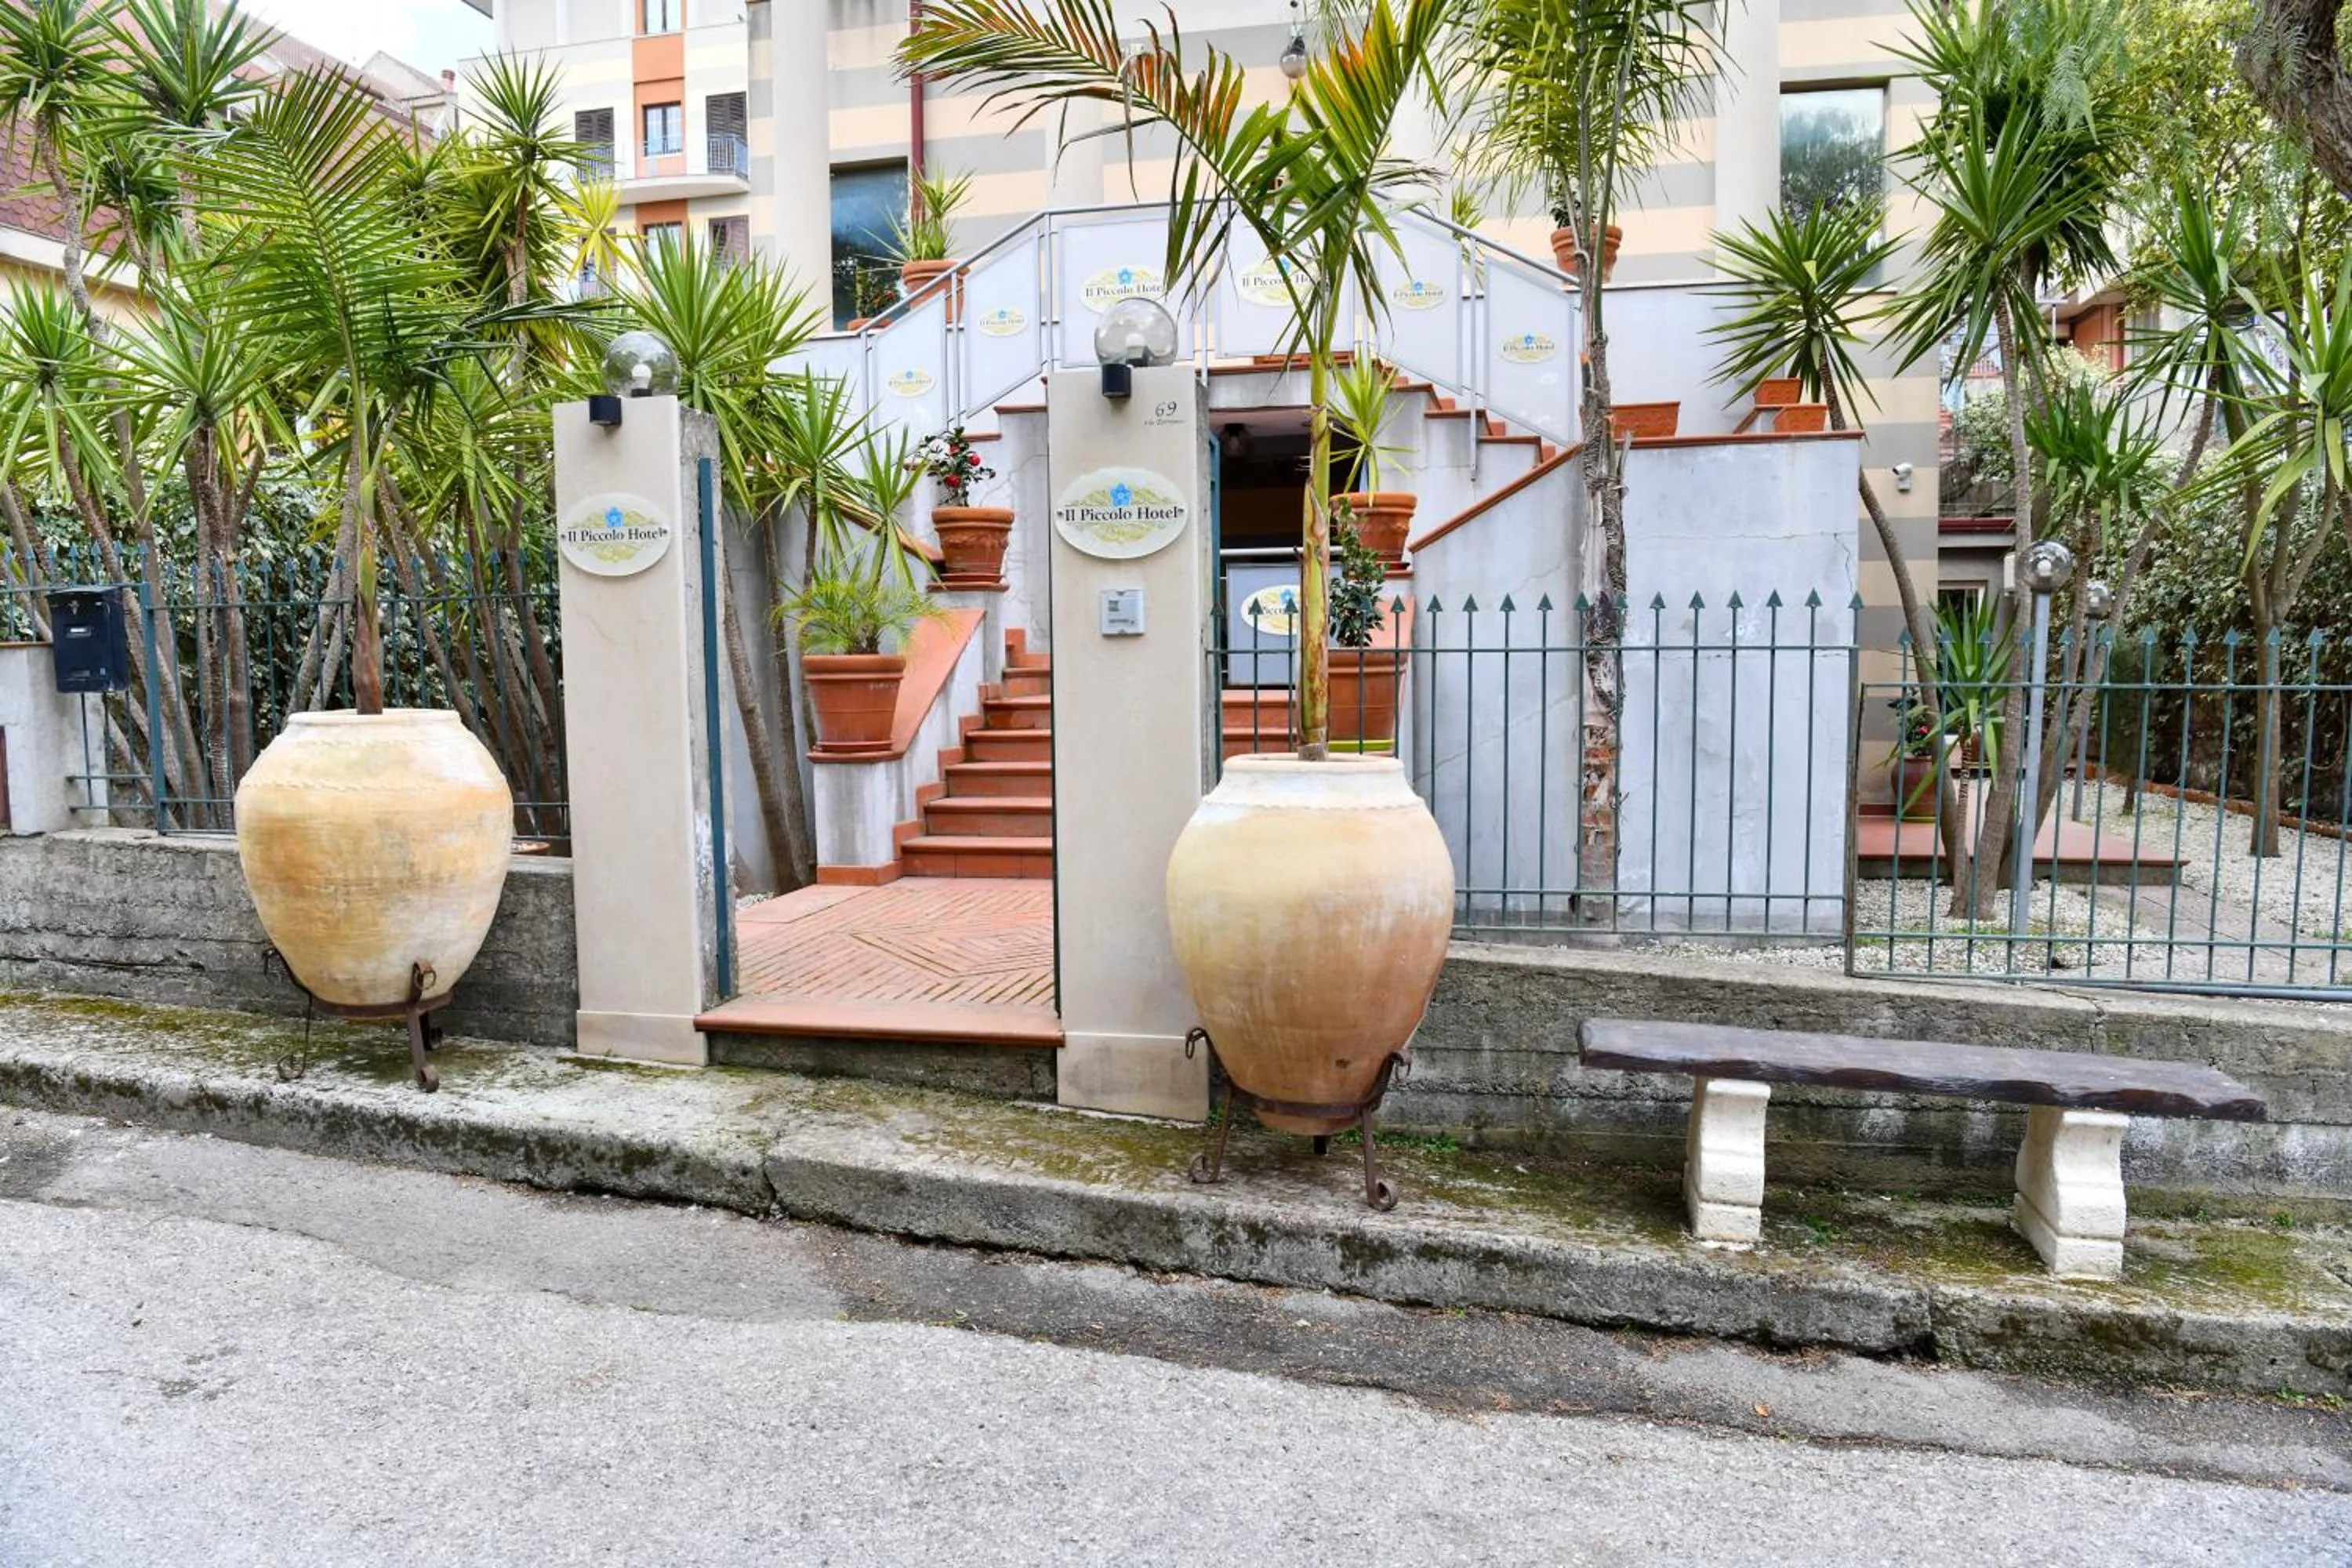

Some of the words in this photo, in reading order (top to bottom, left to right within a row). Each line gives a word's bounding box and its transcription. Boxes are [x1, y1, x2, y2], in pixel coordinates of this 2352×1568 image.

[1136, 284, 1163, 293] Hote
[1155, 401, 1177, 417] 69
[1065, 509, 1075, 521] Il
[1081, 507, 1132, 521] Piccolo
[1137, 506, 1178, 520] Hotel
[568, 530, 577, 543] Il
[581, 528, 625, 542] Piccolo
[628, 527, 663, 540] Hotel
